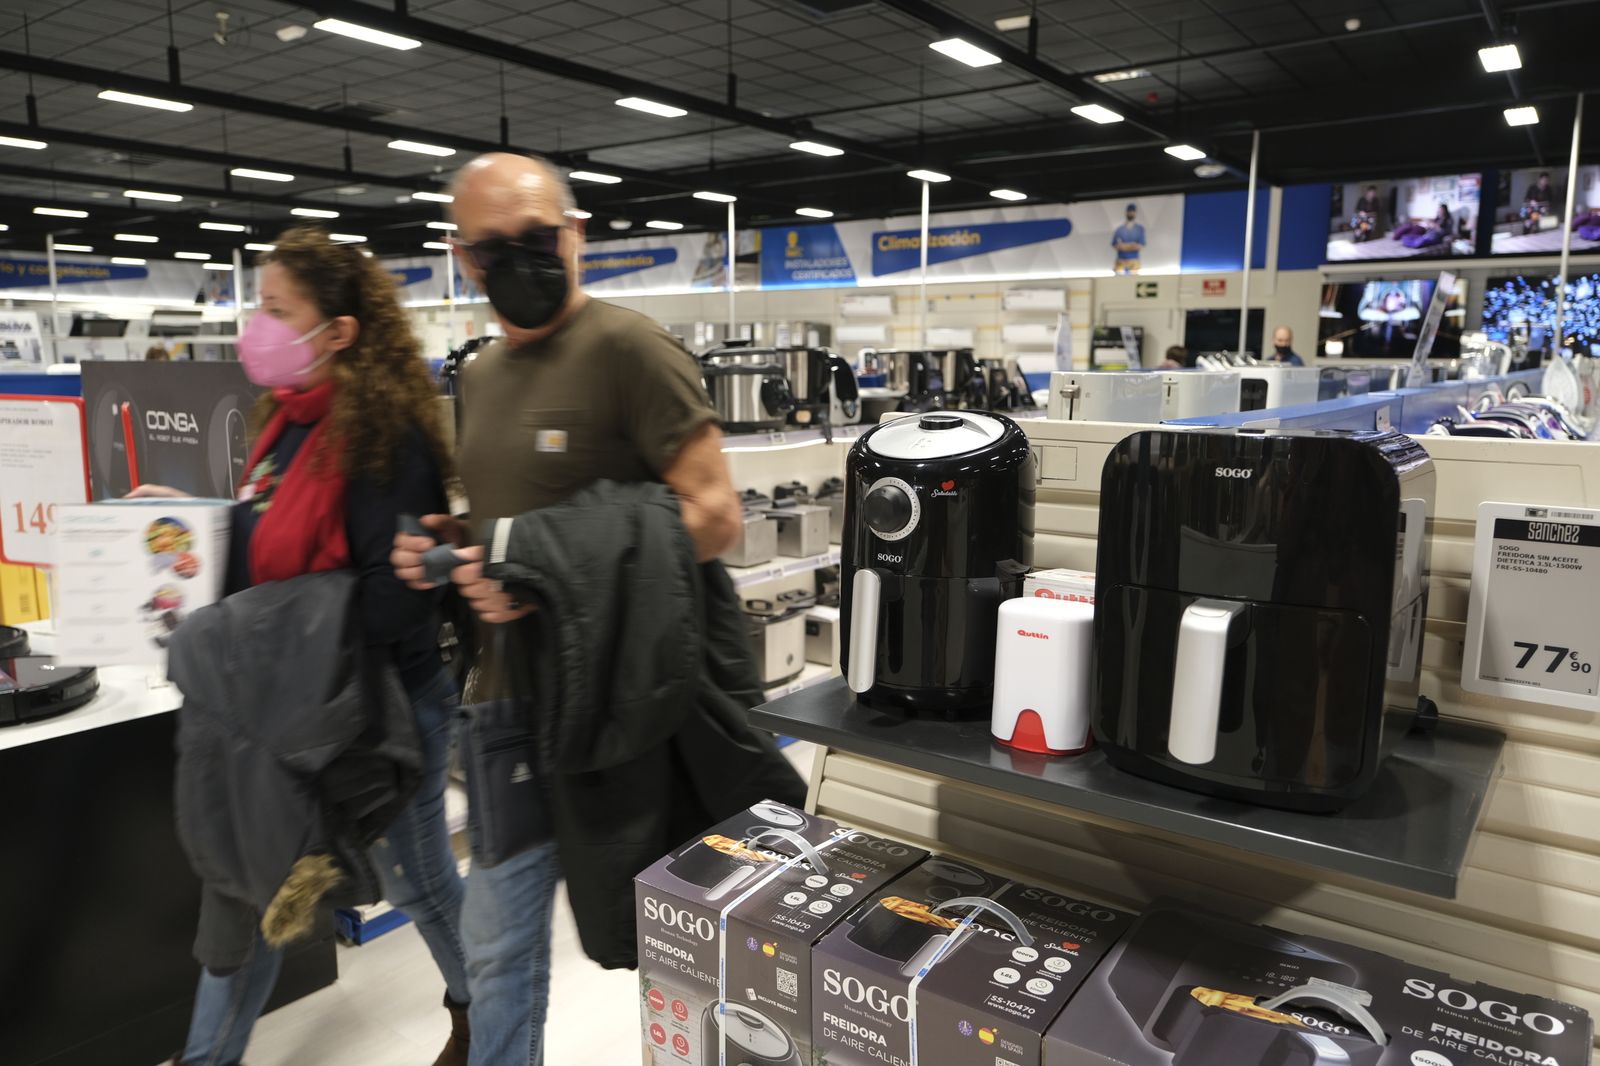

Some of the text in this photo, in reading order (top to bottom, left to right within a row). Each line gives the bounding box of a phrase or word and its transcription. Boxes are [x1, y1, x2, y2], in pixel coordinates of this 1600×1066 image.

[879, 230, 981, 251] Climaización
[146, 410, 199, 432] CONGA
[1215, 467, 1252, 479] SOGO
[877, 553, 902, 563] SOGO
[1496, 557, 1583, 570] DIETETICA 3.5L-1500W
[1497, 551, 1535, 560] FREIDORA
[1496, 564, 1548, 574] FRE-SS-10480
[1017, 629, 1050, 640] Quttin
[1513, 641, 1570, 674] 77
[1570, 661, 1592, 674] 90
[1020, 888, 1117, 922] SOGO
[644, 897, 716, 941] SOGO
[771, 919, 805, 934] www.sogo.es
[776, 914, 811, 930] SS-10470
[1029, 912, 1098, 937] FREIDORA
[1040, 923, 1094, 943] CALIENTE
[644, 935, 696, 964] FREIDORA
[645, 949, 657, 961] DE
[658, 955, 679, 970] AIRE
[823, 968, 909, 1022] SOGO
[990, 995, 1037, 1015] SS-10470
[987, 1001, 1031, 1020] www.sogo.es
[1402, 978, 1566, 1036] SOGO
[823, 1011, 887, 1047] FREIDORA
[1436, 1006, 1523, 1037] Human Technology
[823, 1026, 839, 1041] DE
[840, 1035, 865, 1053] AIRE
[1401, 1025, 1424, 1039] DE
[1428, 1037, 1469, 1053] AIRE
[1430, 1022, 1560, 1066] FREIDORA
